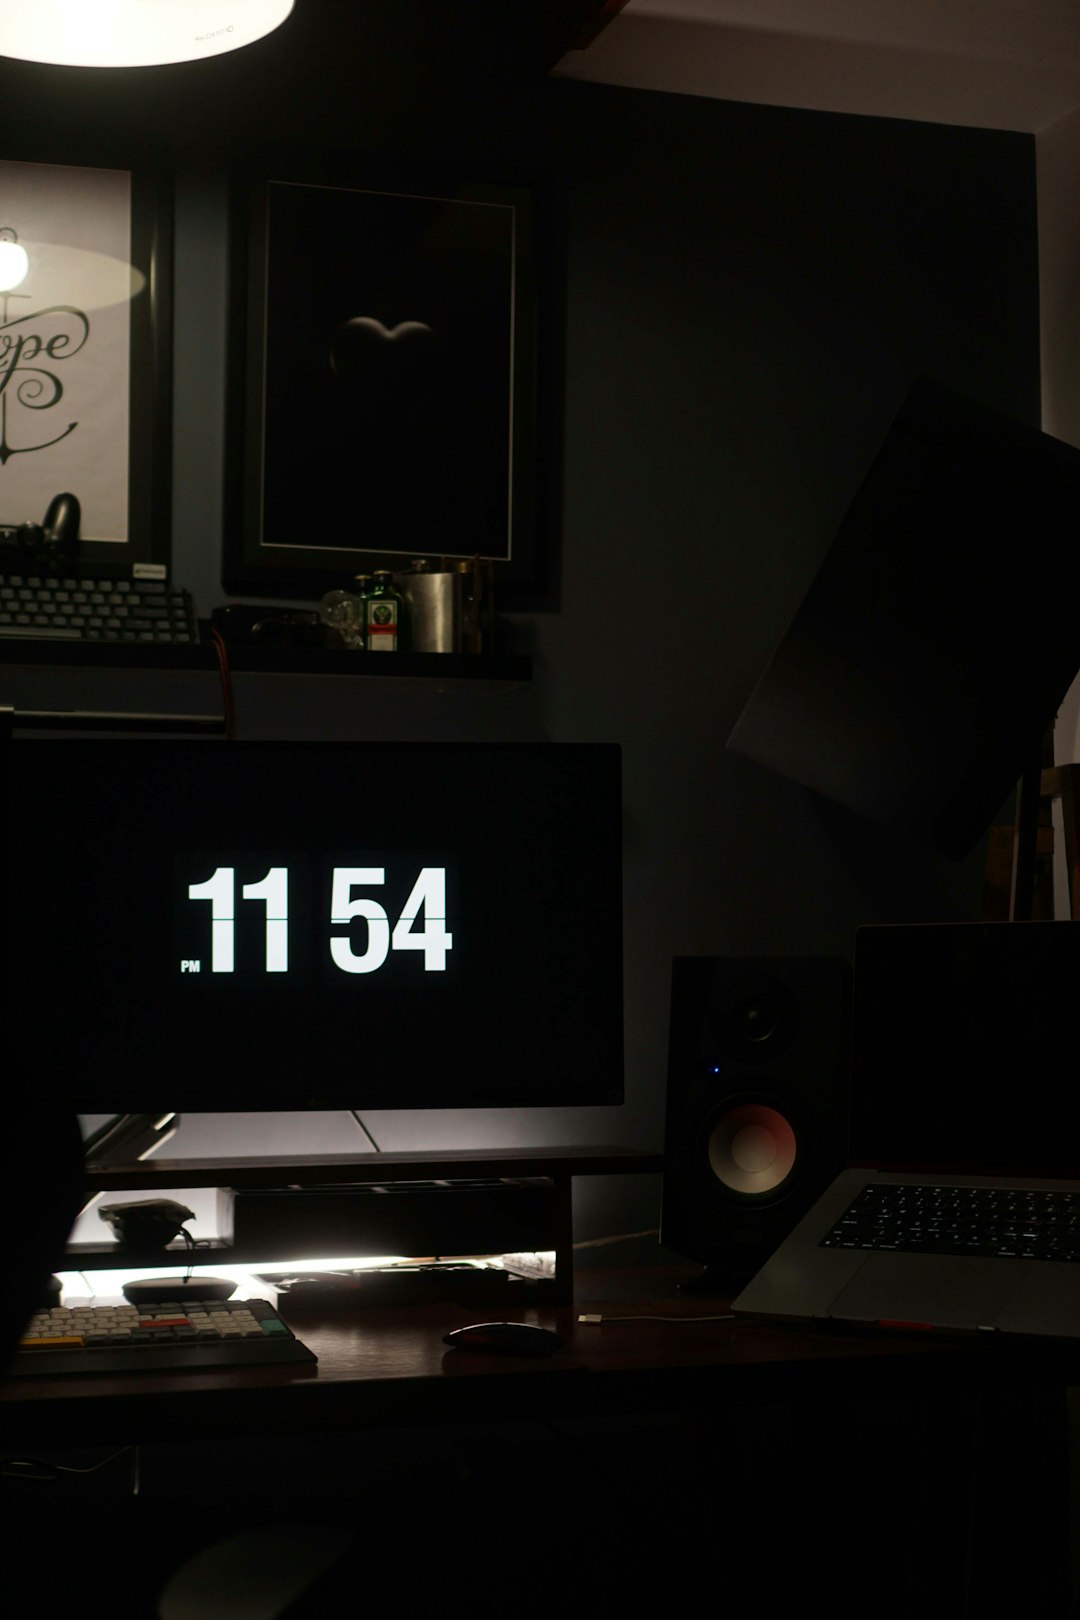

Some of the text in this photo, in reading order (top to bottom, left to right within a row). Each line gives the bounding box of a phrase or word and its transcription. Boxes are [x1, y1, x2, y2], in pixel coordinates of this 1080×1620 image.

[189, 867, 453, 974] 11 54
[180, 959, 201, 973] PM
